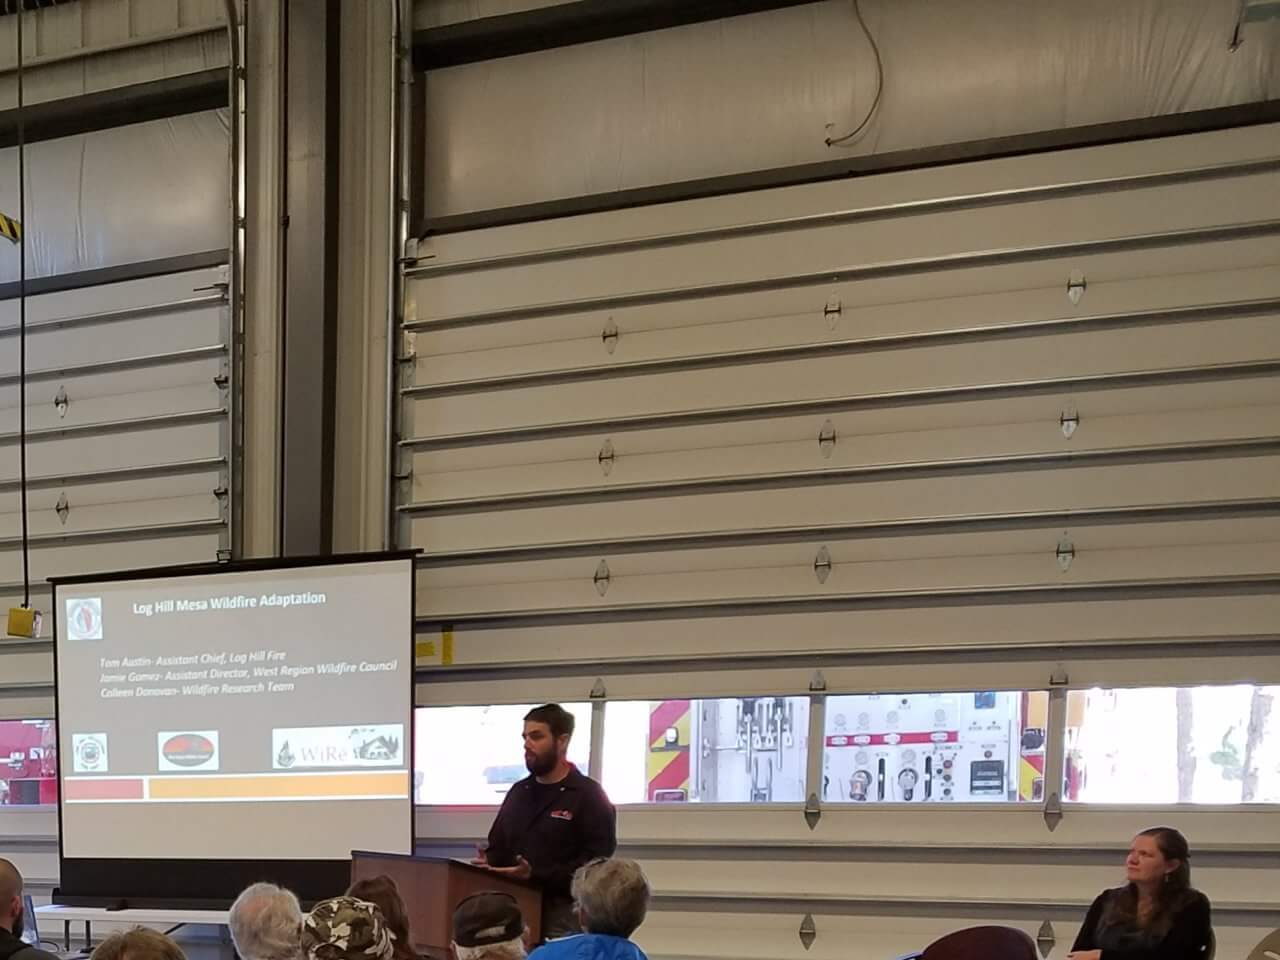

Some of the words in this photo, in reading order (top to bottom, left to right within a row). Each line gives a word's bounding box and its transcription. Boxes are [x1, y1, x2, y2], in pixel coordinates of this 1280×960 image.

[133, 603, 153, 616] Log
[155, 600, 174, 613] Hill
[176, 599, 208, 612] Mesa
[210, 595, 257, 609] Wildfire
[259, 592, 327, 607] Adaptation
[100, 657, 120, 668] Tom
[156, 655, 198, 665] Assistant
[200, 652, 227, 665] Chief,
[229, 653, 247, 665] Log
[249, 651, 266, 661] Hill
[267, 650, 287, 661] Fire
[164, 671, 208, 681] Assistant
[253, 667, 278, 677] West
[280, 665, 315, 678] Region
[316, 662, 357, 675] Wildfire
[359, 660, 398, 672] Council
[100, 687, 134, 698] Colleen
[182, 684, 219, 697] Wildfire
[221, 682, 265, 694] Research
[267, 681, 295, 692] Team
